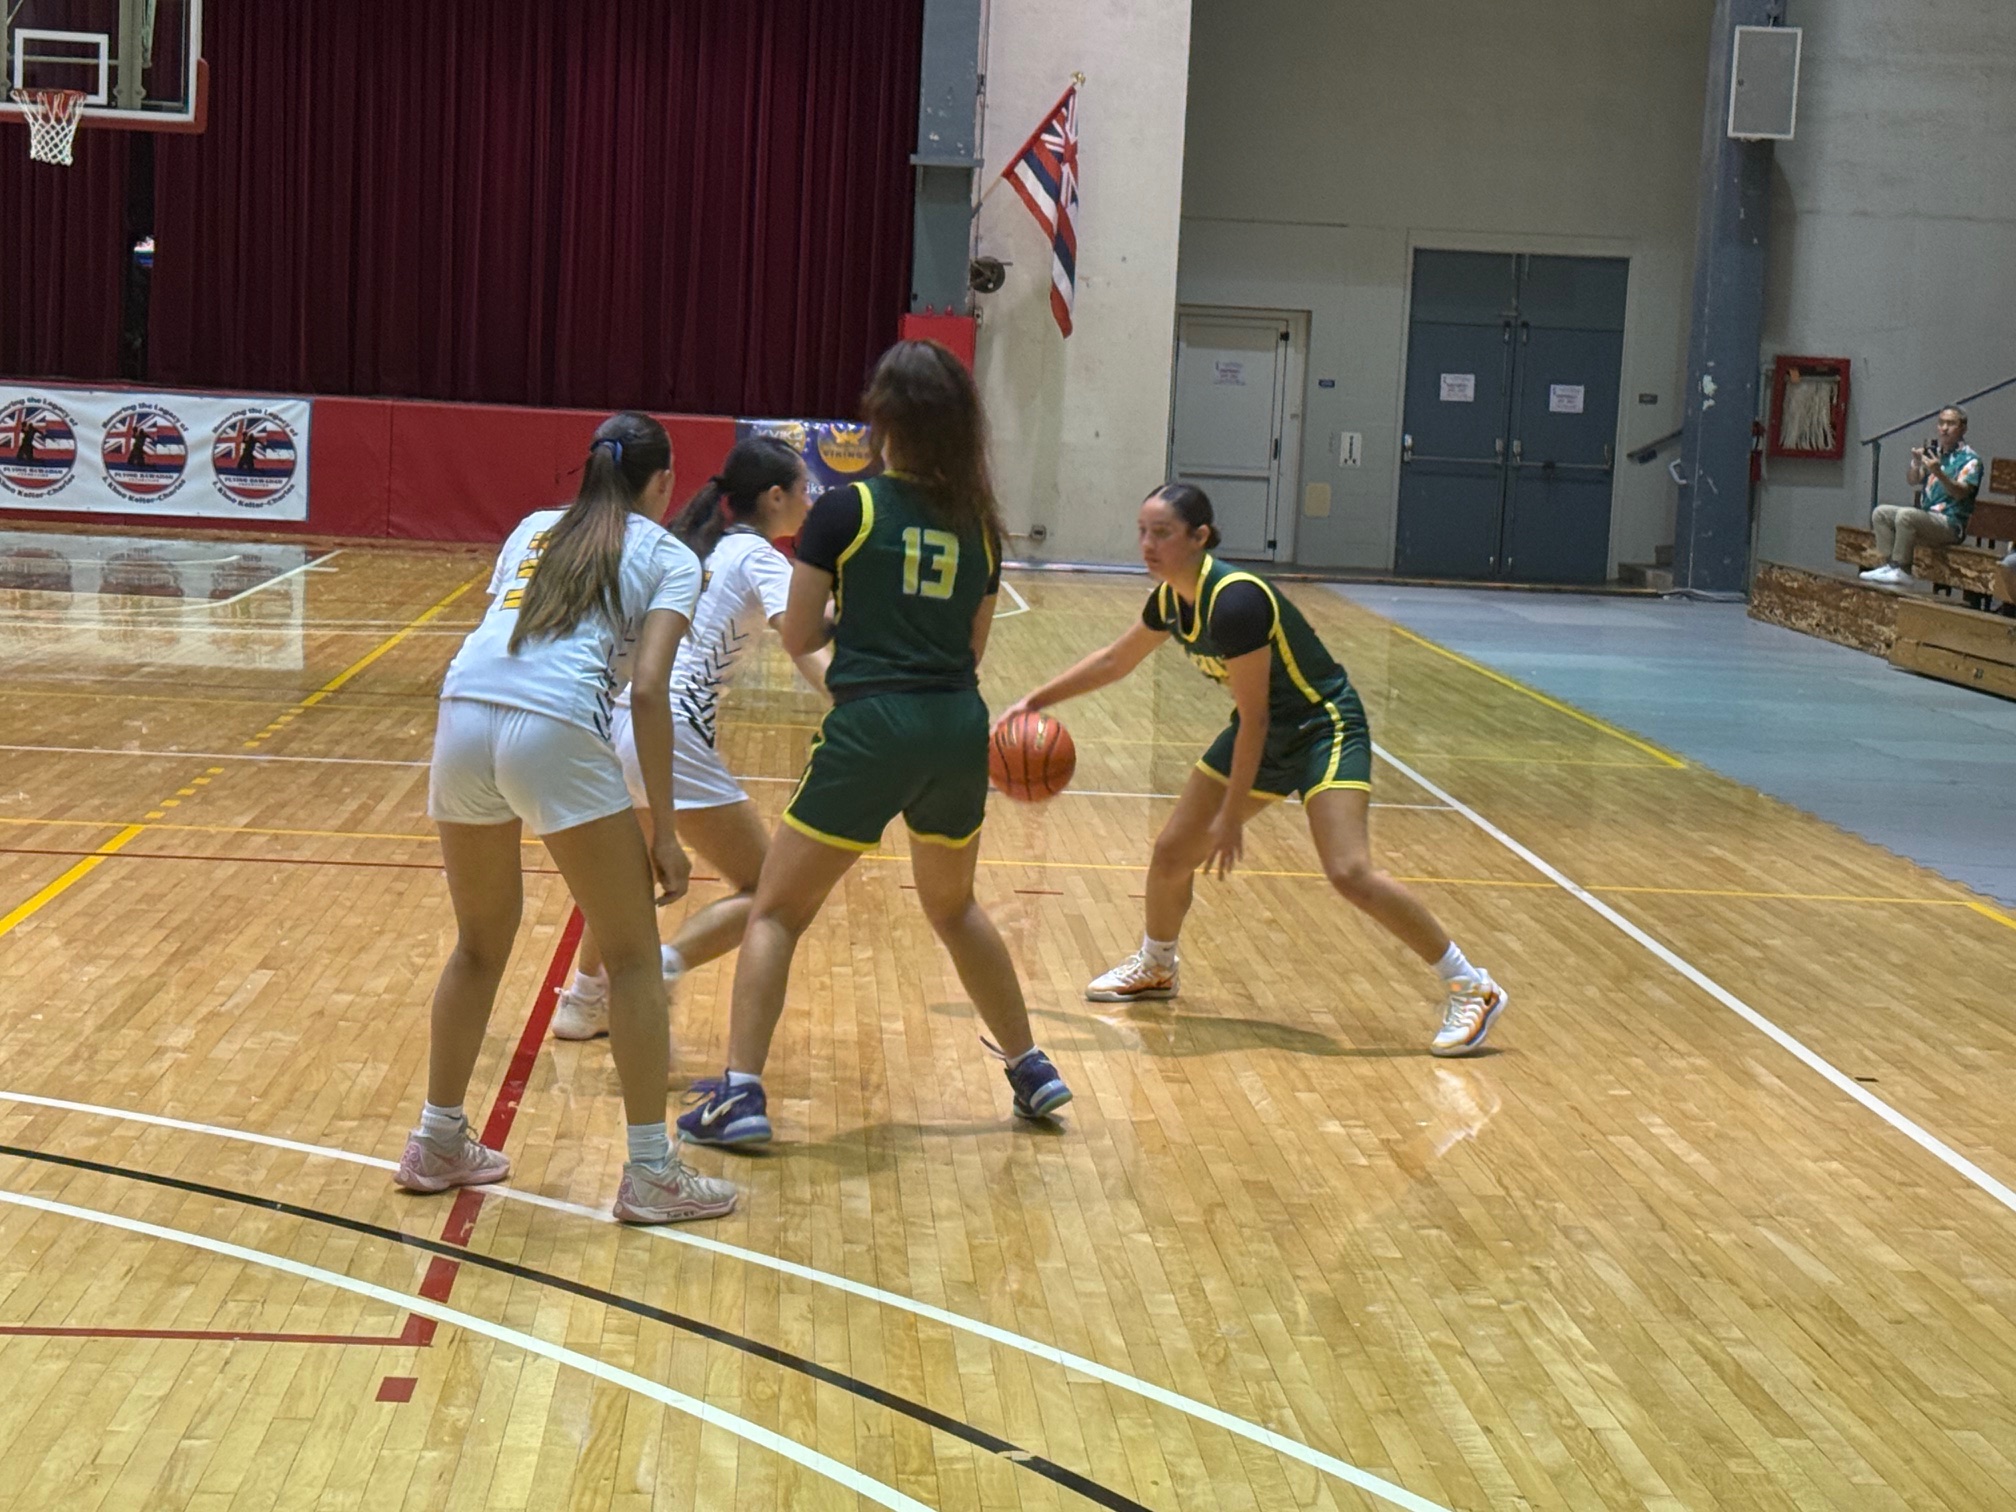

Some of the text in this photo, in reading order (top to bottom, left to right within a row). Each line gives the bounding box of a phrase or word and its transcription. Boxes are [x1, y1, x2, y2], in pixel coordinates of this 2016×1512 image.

[138, 402, 153, 410] the
[154, 404, 180, 424] Legacy
[180, 423, 190, 433] of
[264, 408, 291, 428] Legacy
[289, 428, 299, 437] of
[902, 526, 960, 599] 13
